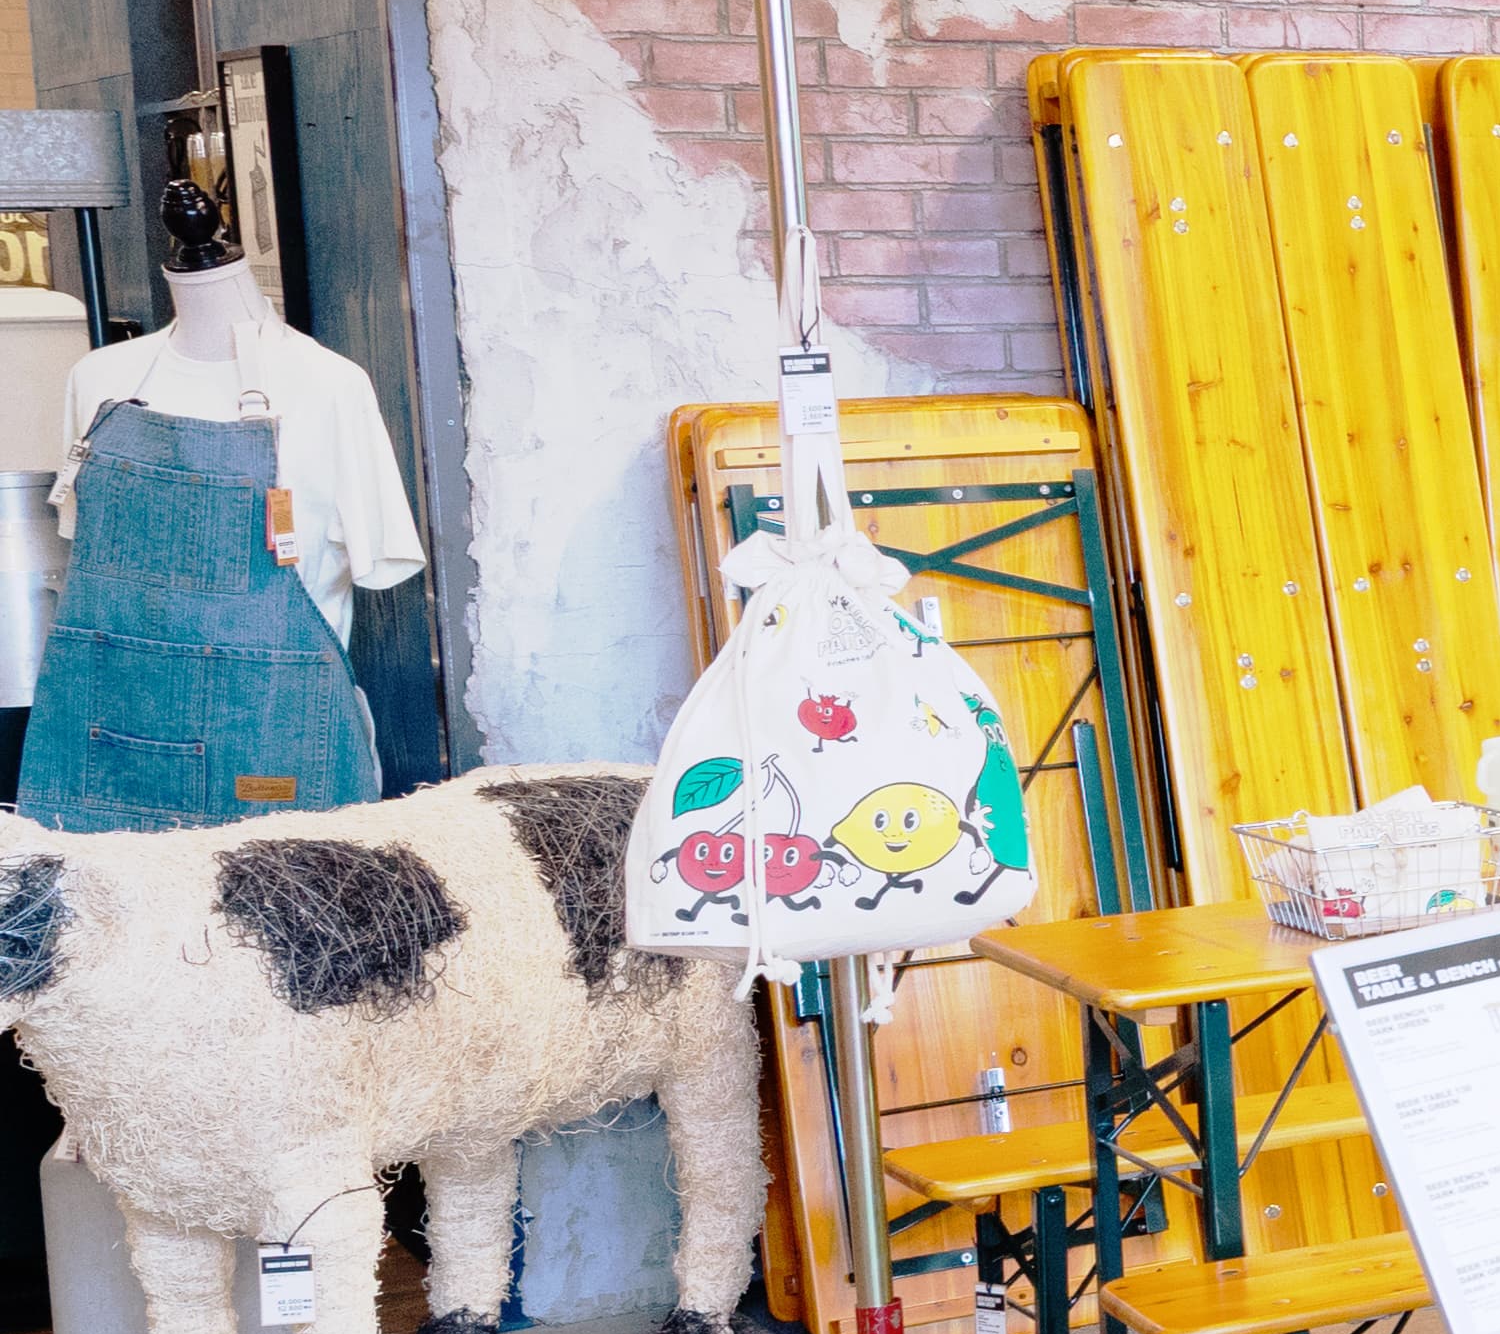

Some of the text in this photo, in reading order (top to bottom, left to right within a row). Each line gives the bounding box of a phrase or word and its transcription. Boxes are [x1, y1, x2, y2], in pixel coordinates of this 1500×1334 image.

[1352, 963, 1404, 987] BEER
[1358, 976, 1418, 1002] TABLE
[1419, 972, 1435, 988] &
[1434, 958, 1498, 984] BENCH
[1368, 1016, 1430, 1037] DARK GREEN
[1398, 1097, 1460, 1120] DARK GREEN
[1428, 1179, 1489, 1202] DARK GREEN
[1459, 1271, 1485, 1285] DARK
